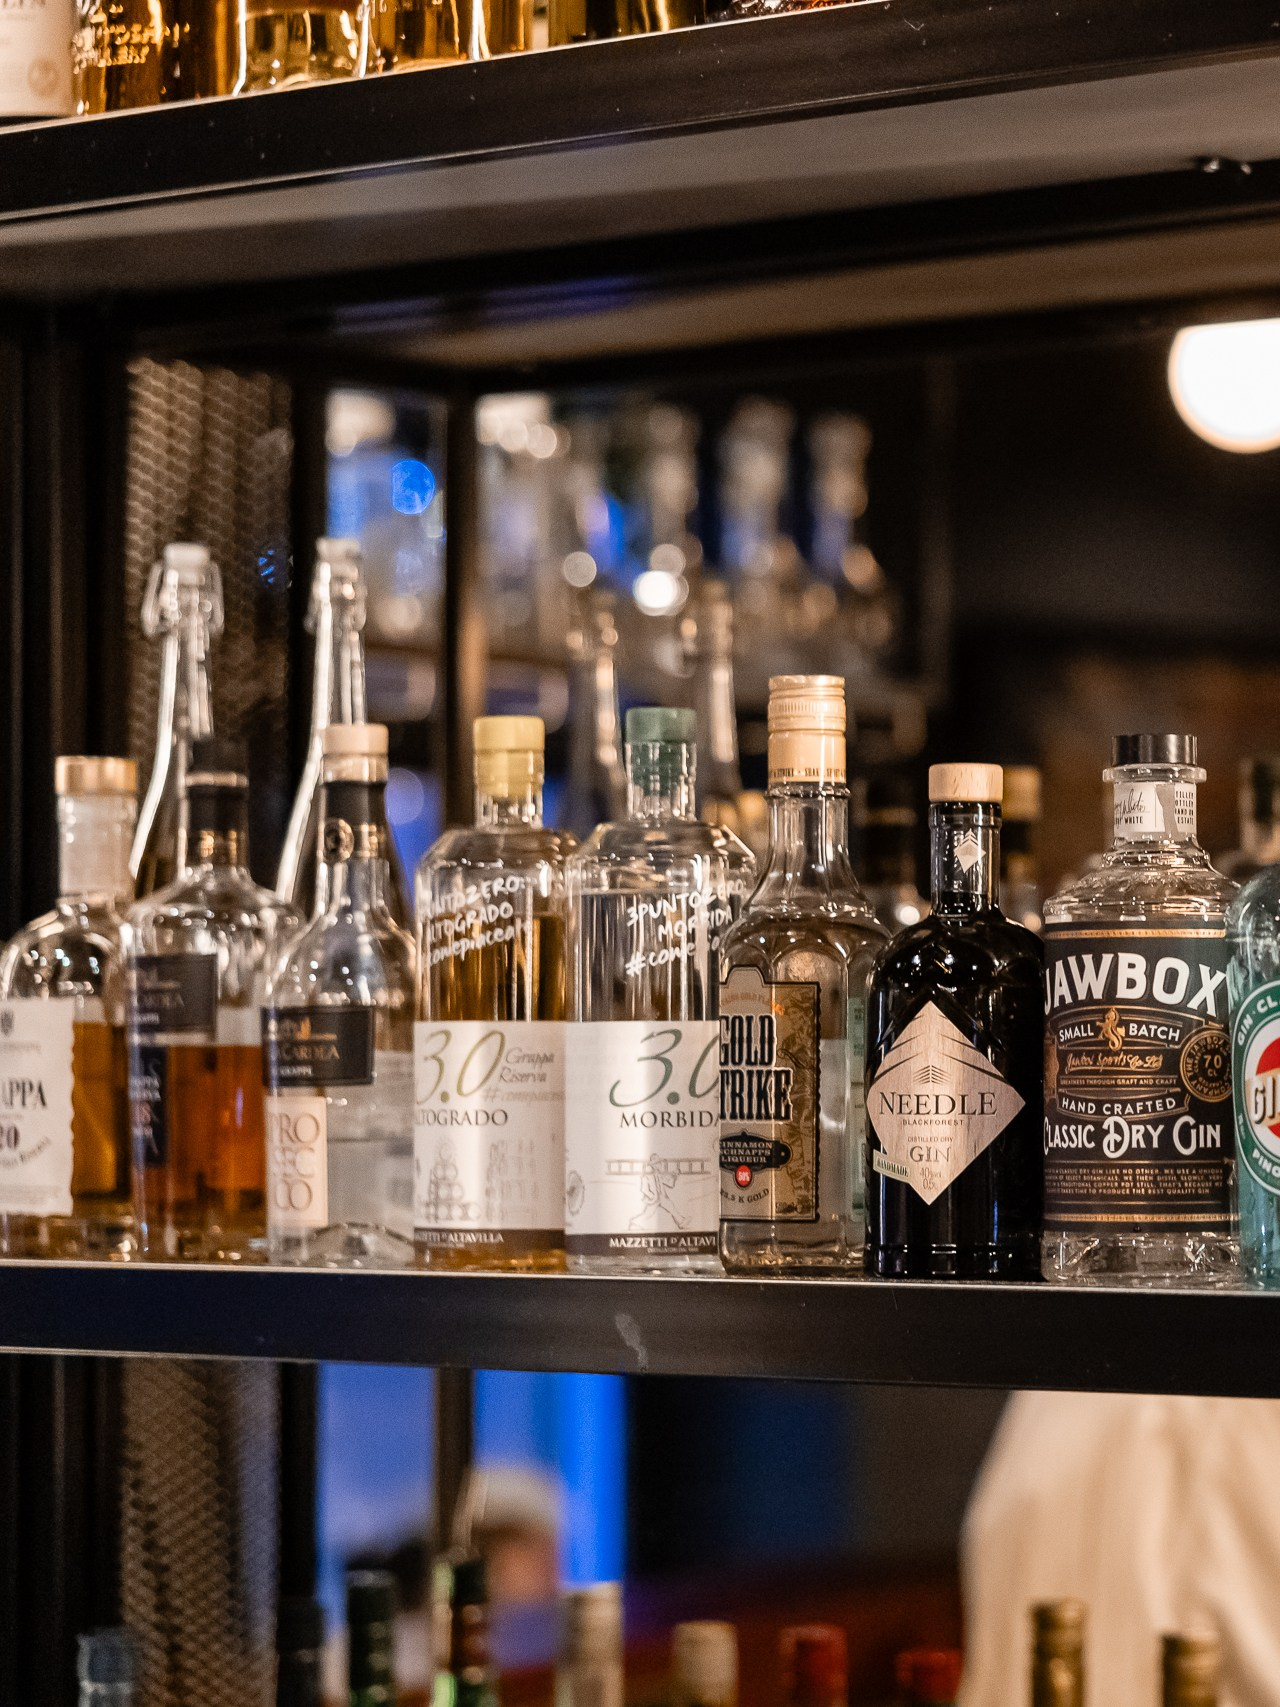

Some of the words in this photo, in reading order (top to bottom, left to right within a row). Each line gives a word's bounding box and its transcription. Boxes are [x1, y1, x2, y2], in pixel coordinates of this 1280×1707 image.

[1044, 952, 1226, 1017] JAWBOX
[720, 1015, 774, 1066] GOLD
[1059, 1023, 1094, 1042] SMALL
[1129, 1023, 1180, 1042] BATCH
[1237, 1014, 1254, 1046] GIN
[416, 1029, 506, 1105] 3.0
[505, 1047, 554, 1068] Grappa
[1203, 1054, 1222, 1069] 70
[720, 1069, 792, 1121] TRIKE
[879, 1091, 997, 1116] NEEDLE
[1062, 1097, 1096, 1114] HAND
[1102, 1097, 1176, 1115] CRAFTED
[1044, 1116, 1096, 1155] CLASSIC
[1172, 1115, 1221, 1156] GIN
[909, 1146, 952, 1163] GIN
[876, 1158, 909, 1179] HANDMADE
[747, 1188, 770, 1203] GOLD
[609, 1237, 668, 1248] MAZZETTI
